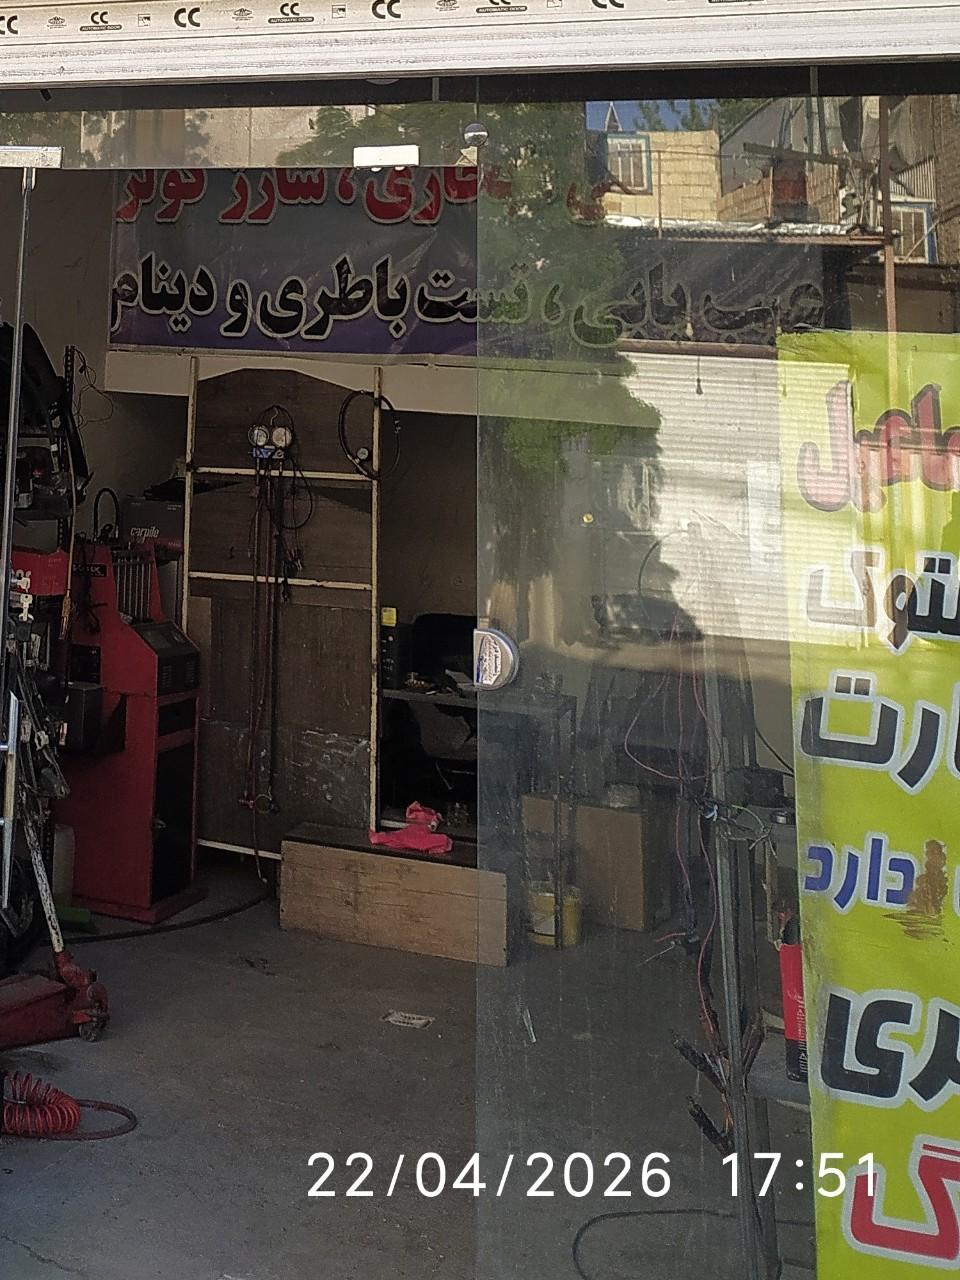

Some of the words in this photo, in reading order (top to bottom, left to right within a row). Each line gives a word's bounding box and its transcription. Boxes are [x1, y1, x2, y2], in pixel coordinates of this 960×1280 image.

[111, 252, 216, 332] دینام
[221, 279, 252, 337] و
[257, 253, 410, 340] باطری
